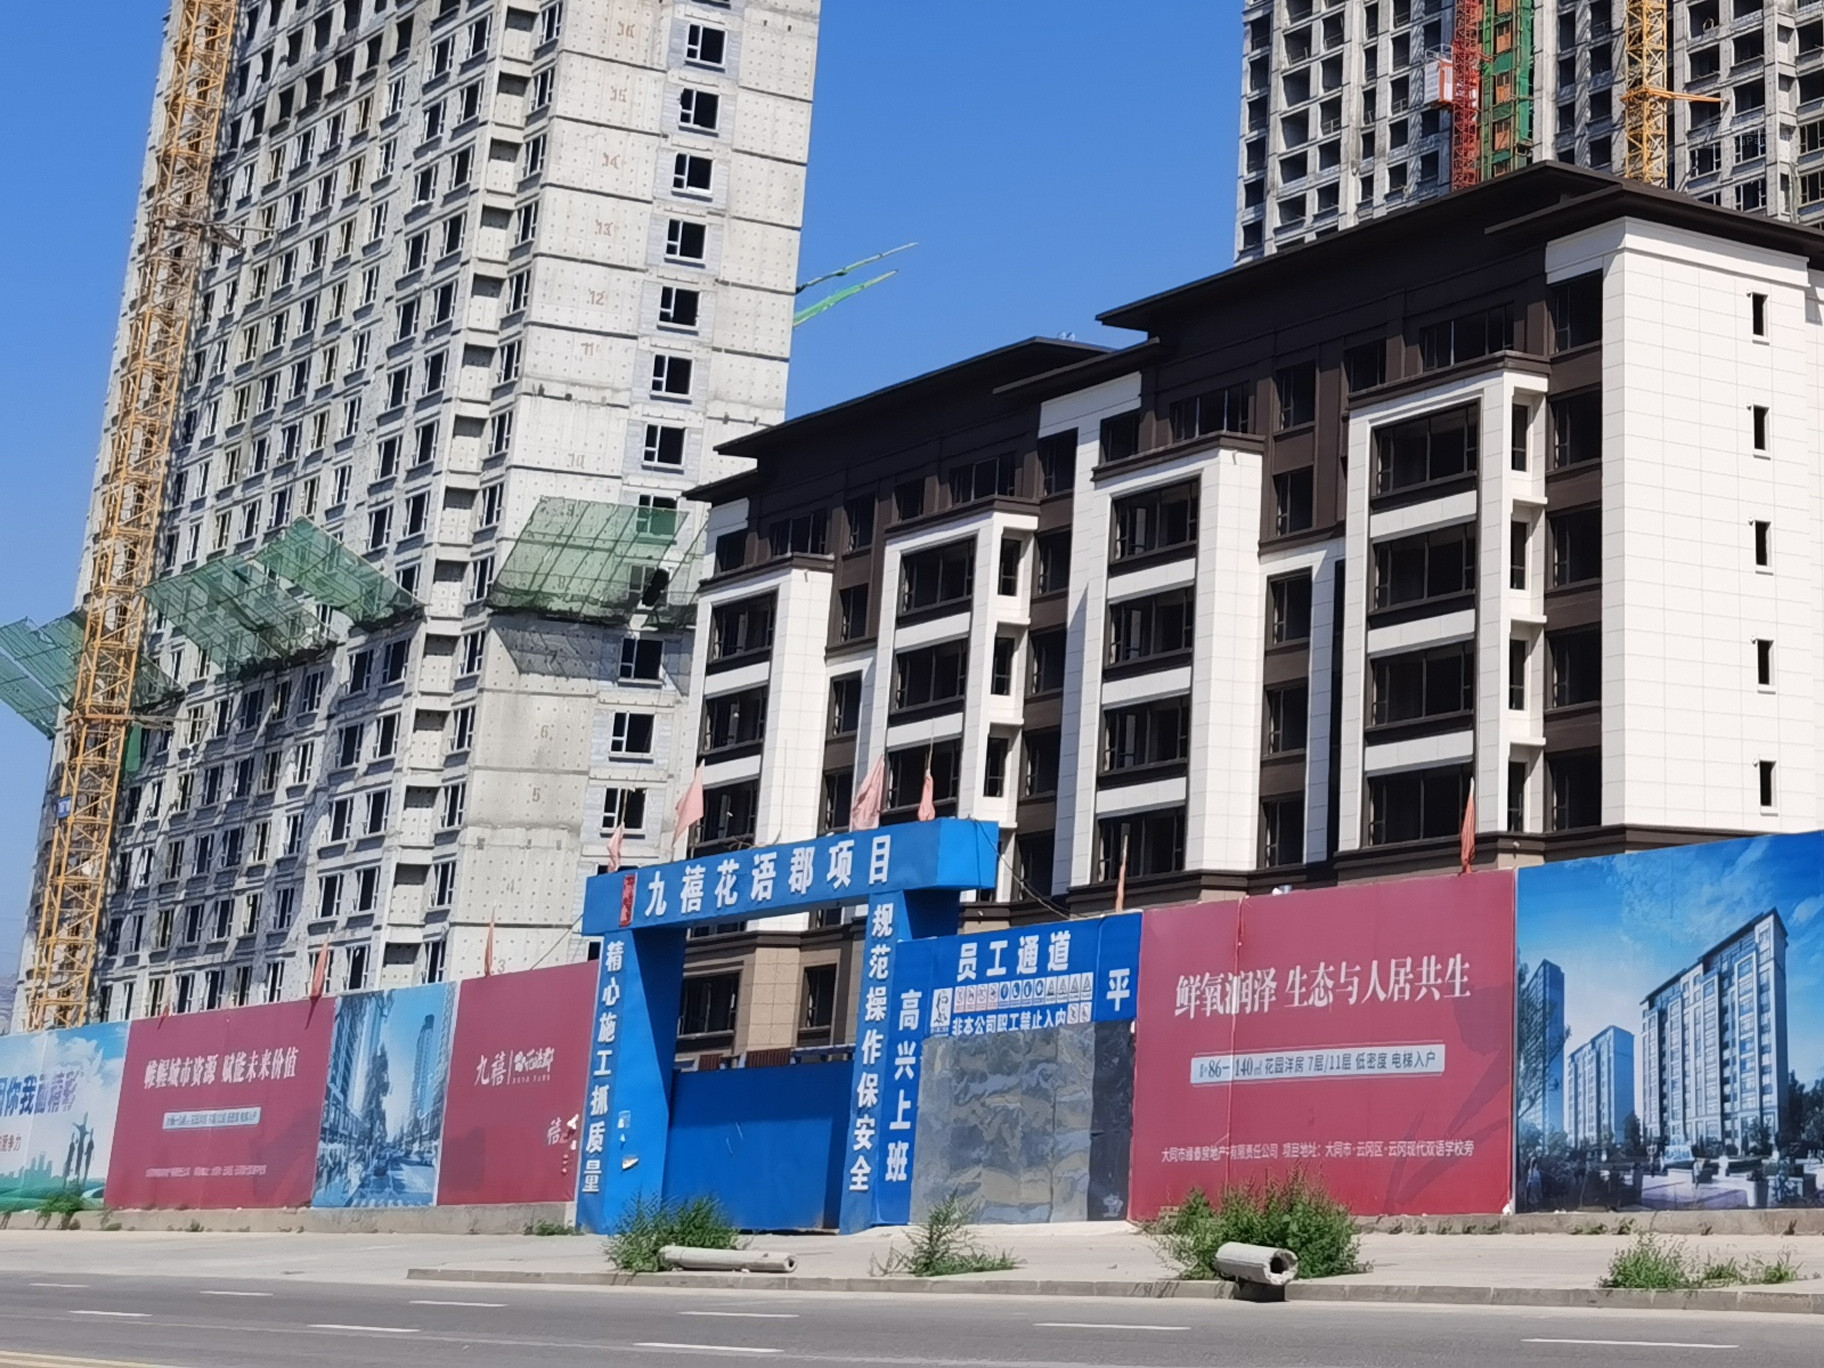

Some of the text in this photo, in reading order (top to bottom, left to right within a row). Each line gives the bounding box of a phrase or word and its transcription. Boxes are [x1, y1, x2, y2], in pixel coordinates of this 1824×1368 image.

[532, 787, 541, 802] 5
[645, 834, 893, 917] 九禧花语郡项目
[957, 930, 1071, 982] 员工通道
[1175, 953, 1471, 1019] 鲜氧润泽 生态与人居共生
[952, 1008, 1067, 1036] 非本公司职工禁止入内
[1106, 968, 1130, 1012] 平
[581, 940, 626, 1193] 精心施工抓质量
[849, 904, 894, 1192] 规范操作保安全
[885, 989, 923, 1182] 高兴上班
